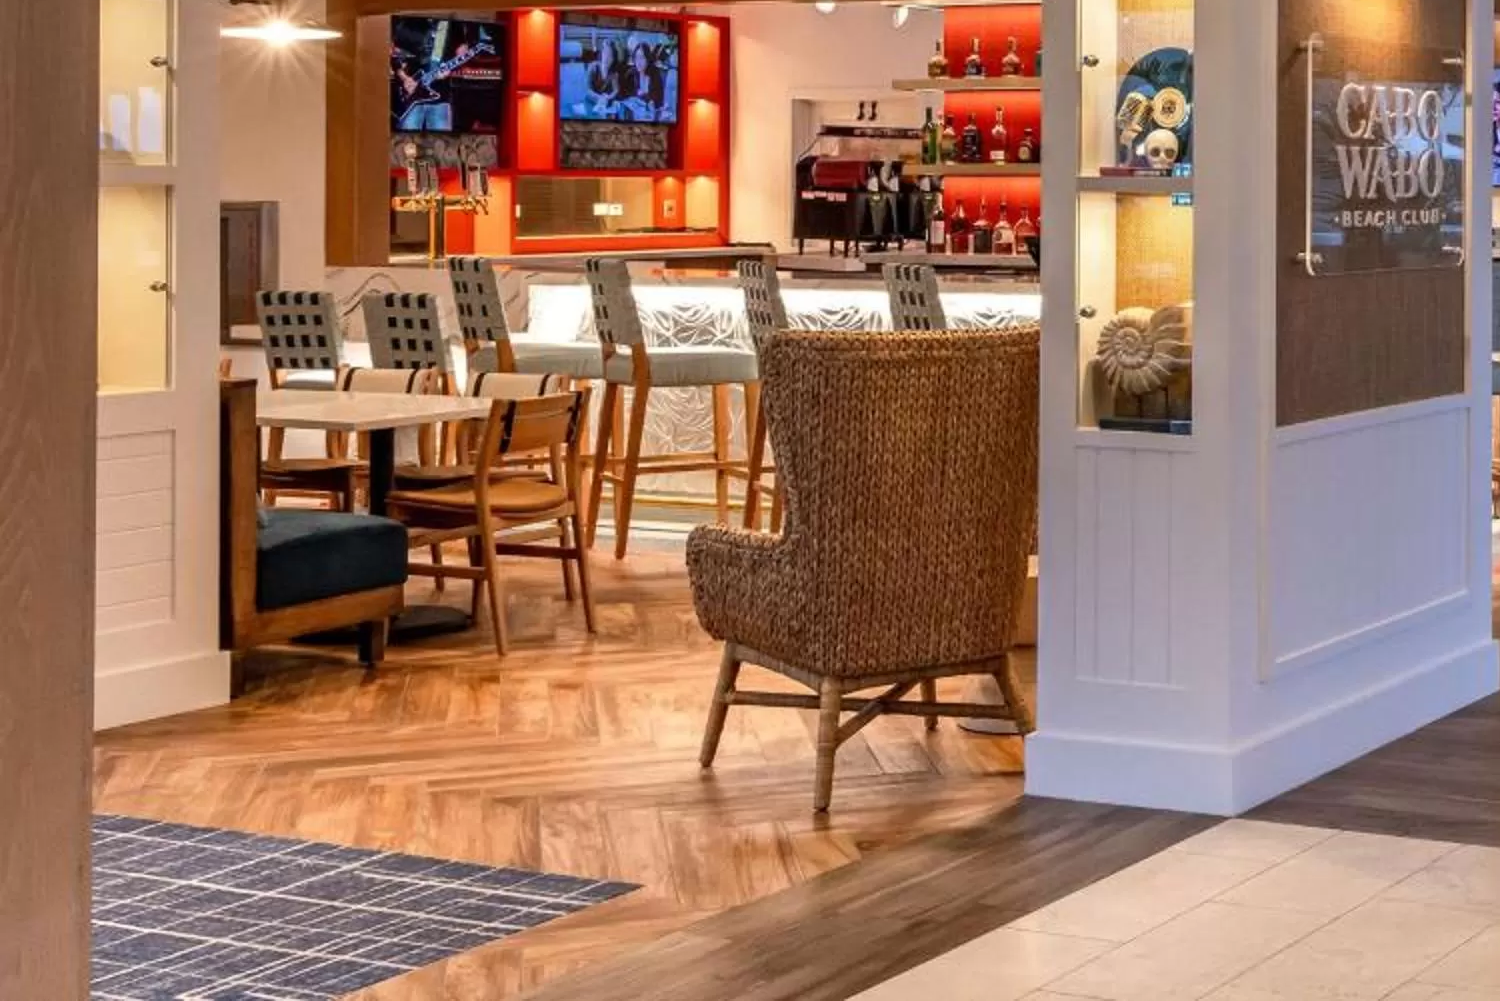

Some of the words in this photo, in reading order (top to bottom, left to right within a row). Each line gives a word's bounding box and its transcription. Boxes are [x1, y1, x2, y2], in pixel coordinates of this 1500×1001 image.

[1336, 82, 1443, 142] CABO
[1335, 142, 1445, 203] WABO
[1341, 210, 1397, 228] BEACH
[1401, 207, 1439, 225] CLUB
